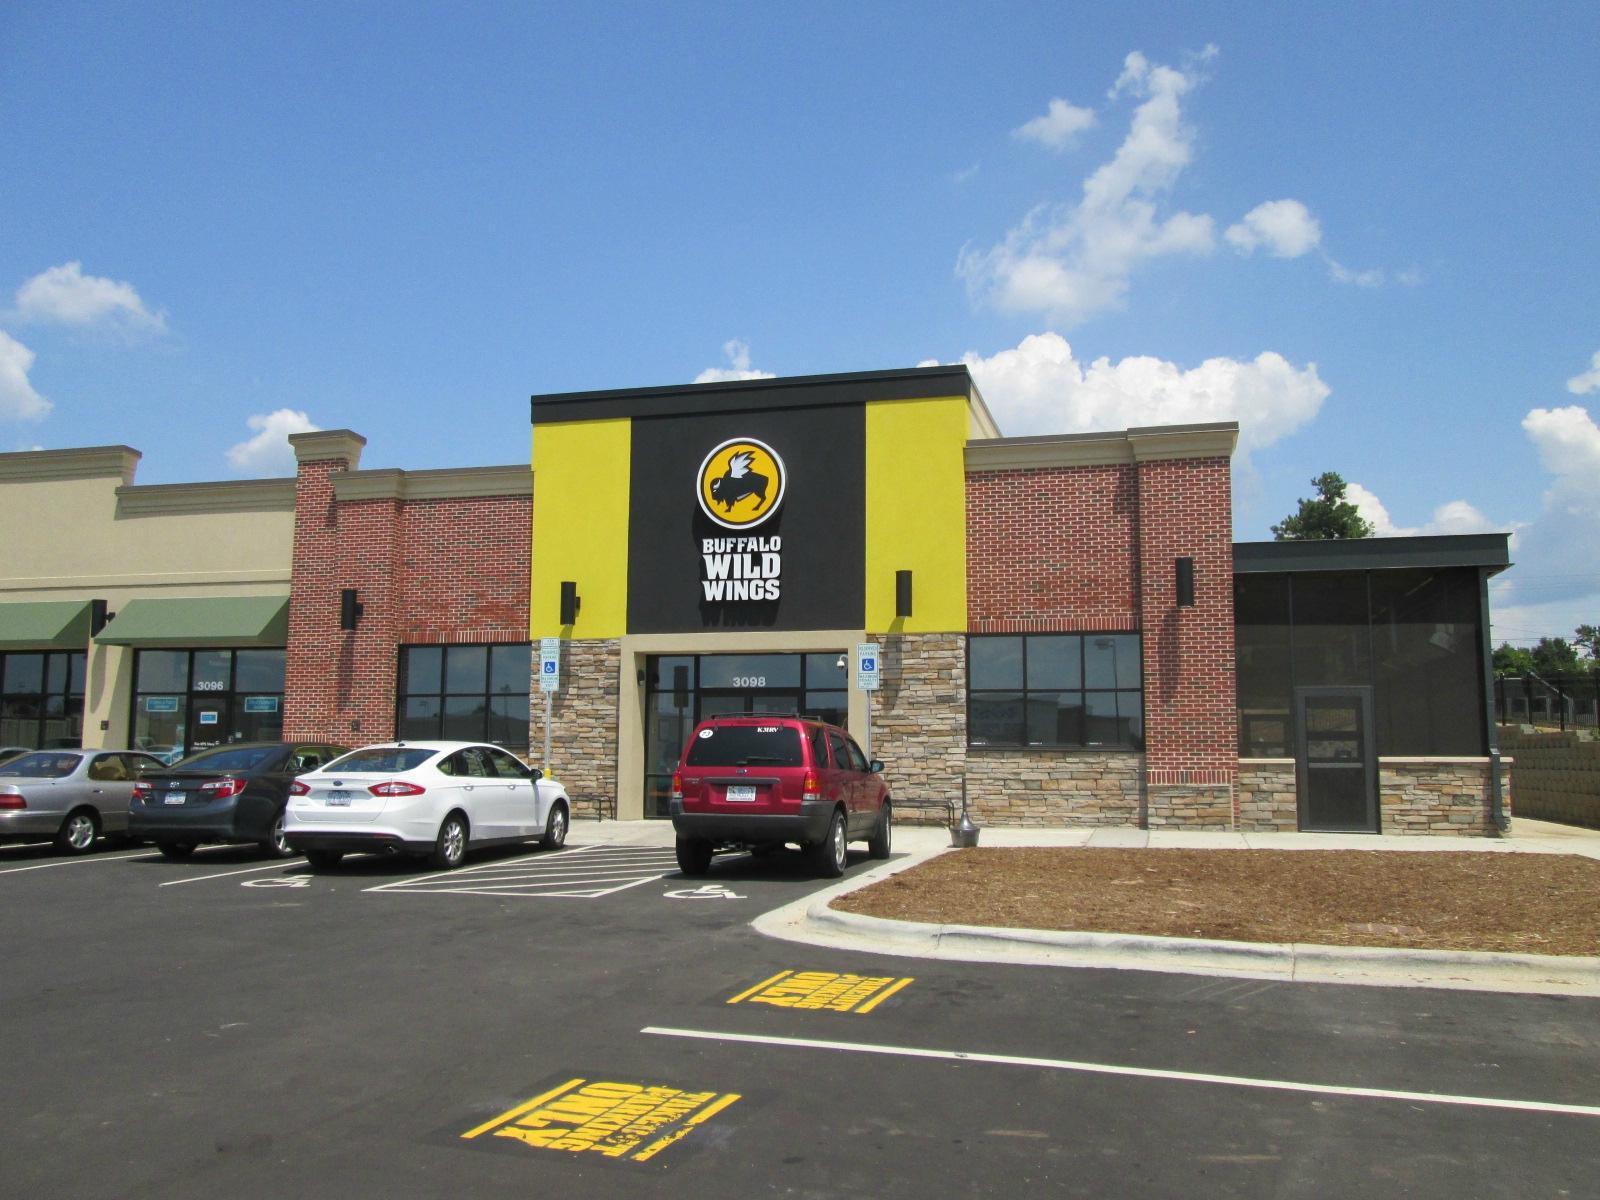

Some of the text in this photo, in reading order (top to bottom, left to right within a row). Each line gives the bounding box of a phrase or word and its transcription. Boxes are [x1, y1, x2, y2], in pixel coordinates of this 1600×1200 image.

[702, 536, 782, 554] BUFFALO
[702, 552, 781, 580] WILD
[702, 579, 781, 602] WINGS
[197, 681, 224, 691] 3096
[732, 676, 766, 688] 3098
[749, 971, 841, 1008] ONLY
[792, 974, 859, 1010] PARKING
[493, 1082, 644, 1148] ONLY
[547, 1086, 684, 1152] PARKING
